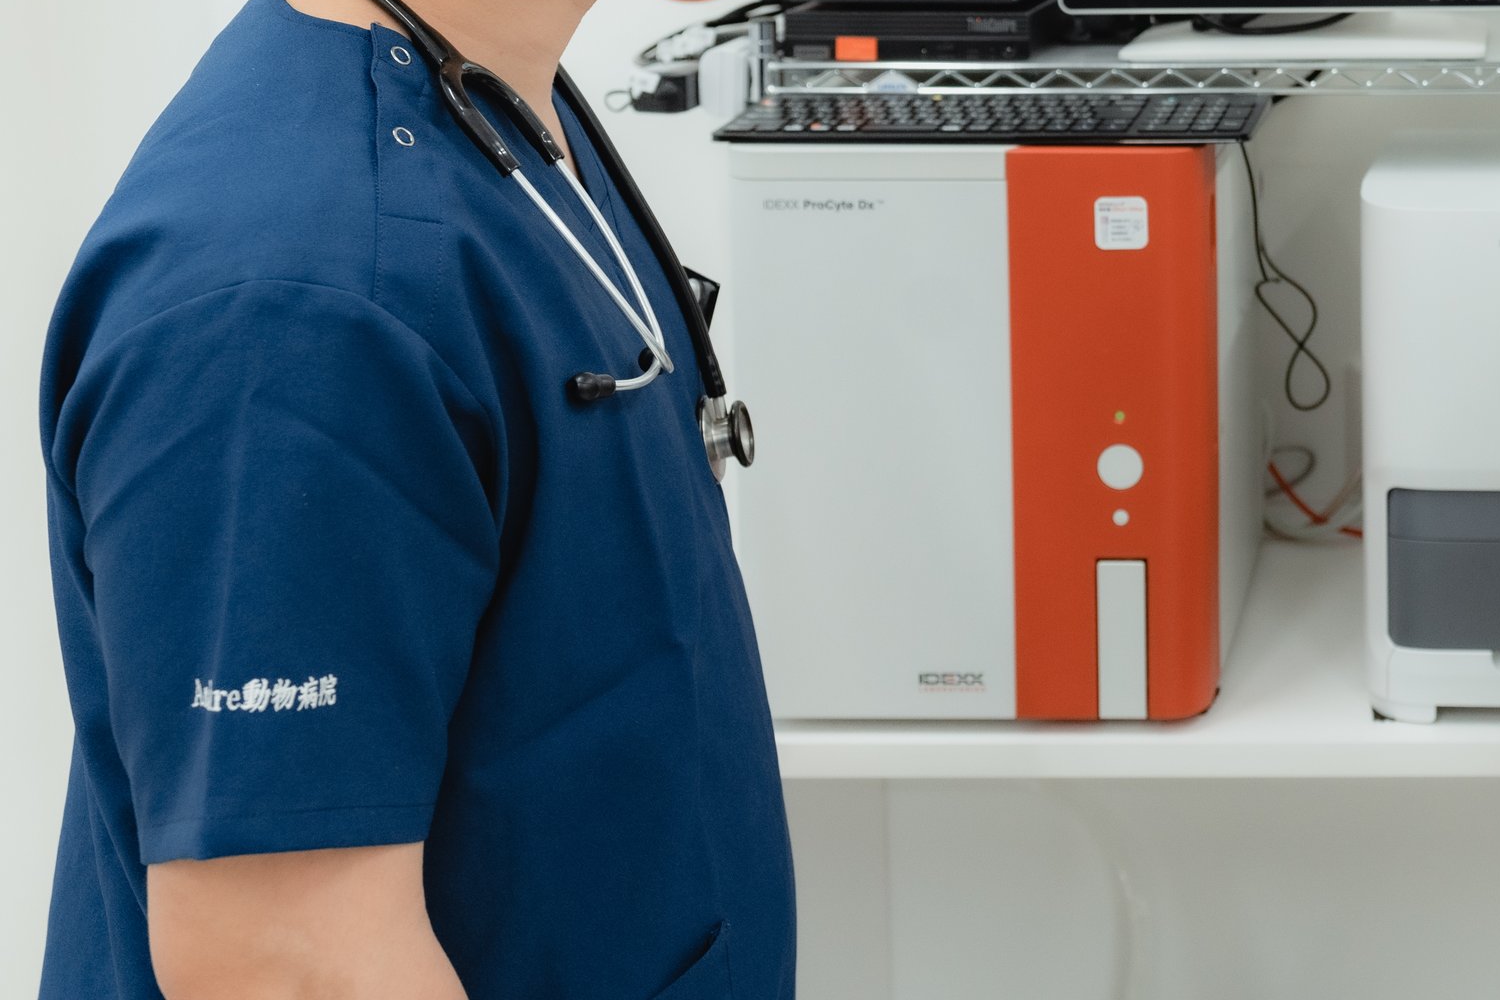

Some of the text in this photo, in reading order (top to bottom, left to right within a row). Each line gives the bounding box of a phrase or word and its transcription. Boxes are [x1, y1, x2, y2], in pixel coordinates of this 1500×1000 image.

[802, 199, 854, 211] ProCyte
[857, 199, 875, 210] Dx
[919, 673, 984, 686] IDEXX
